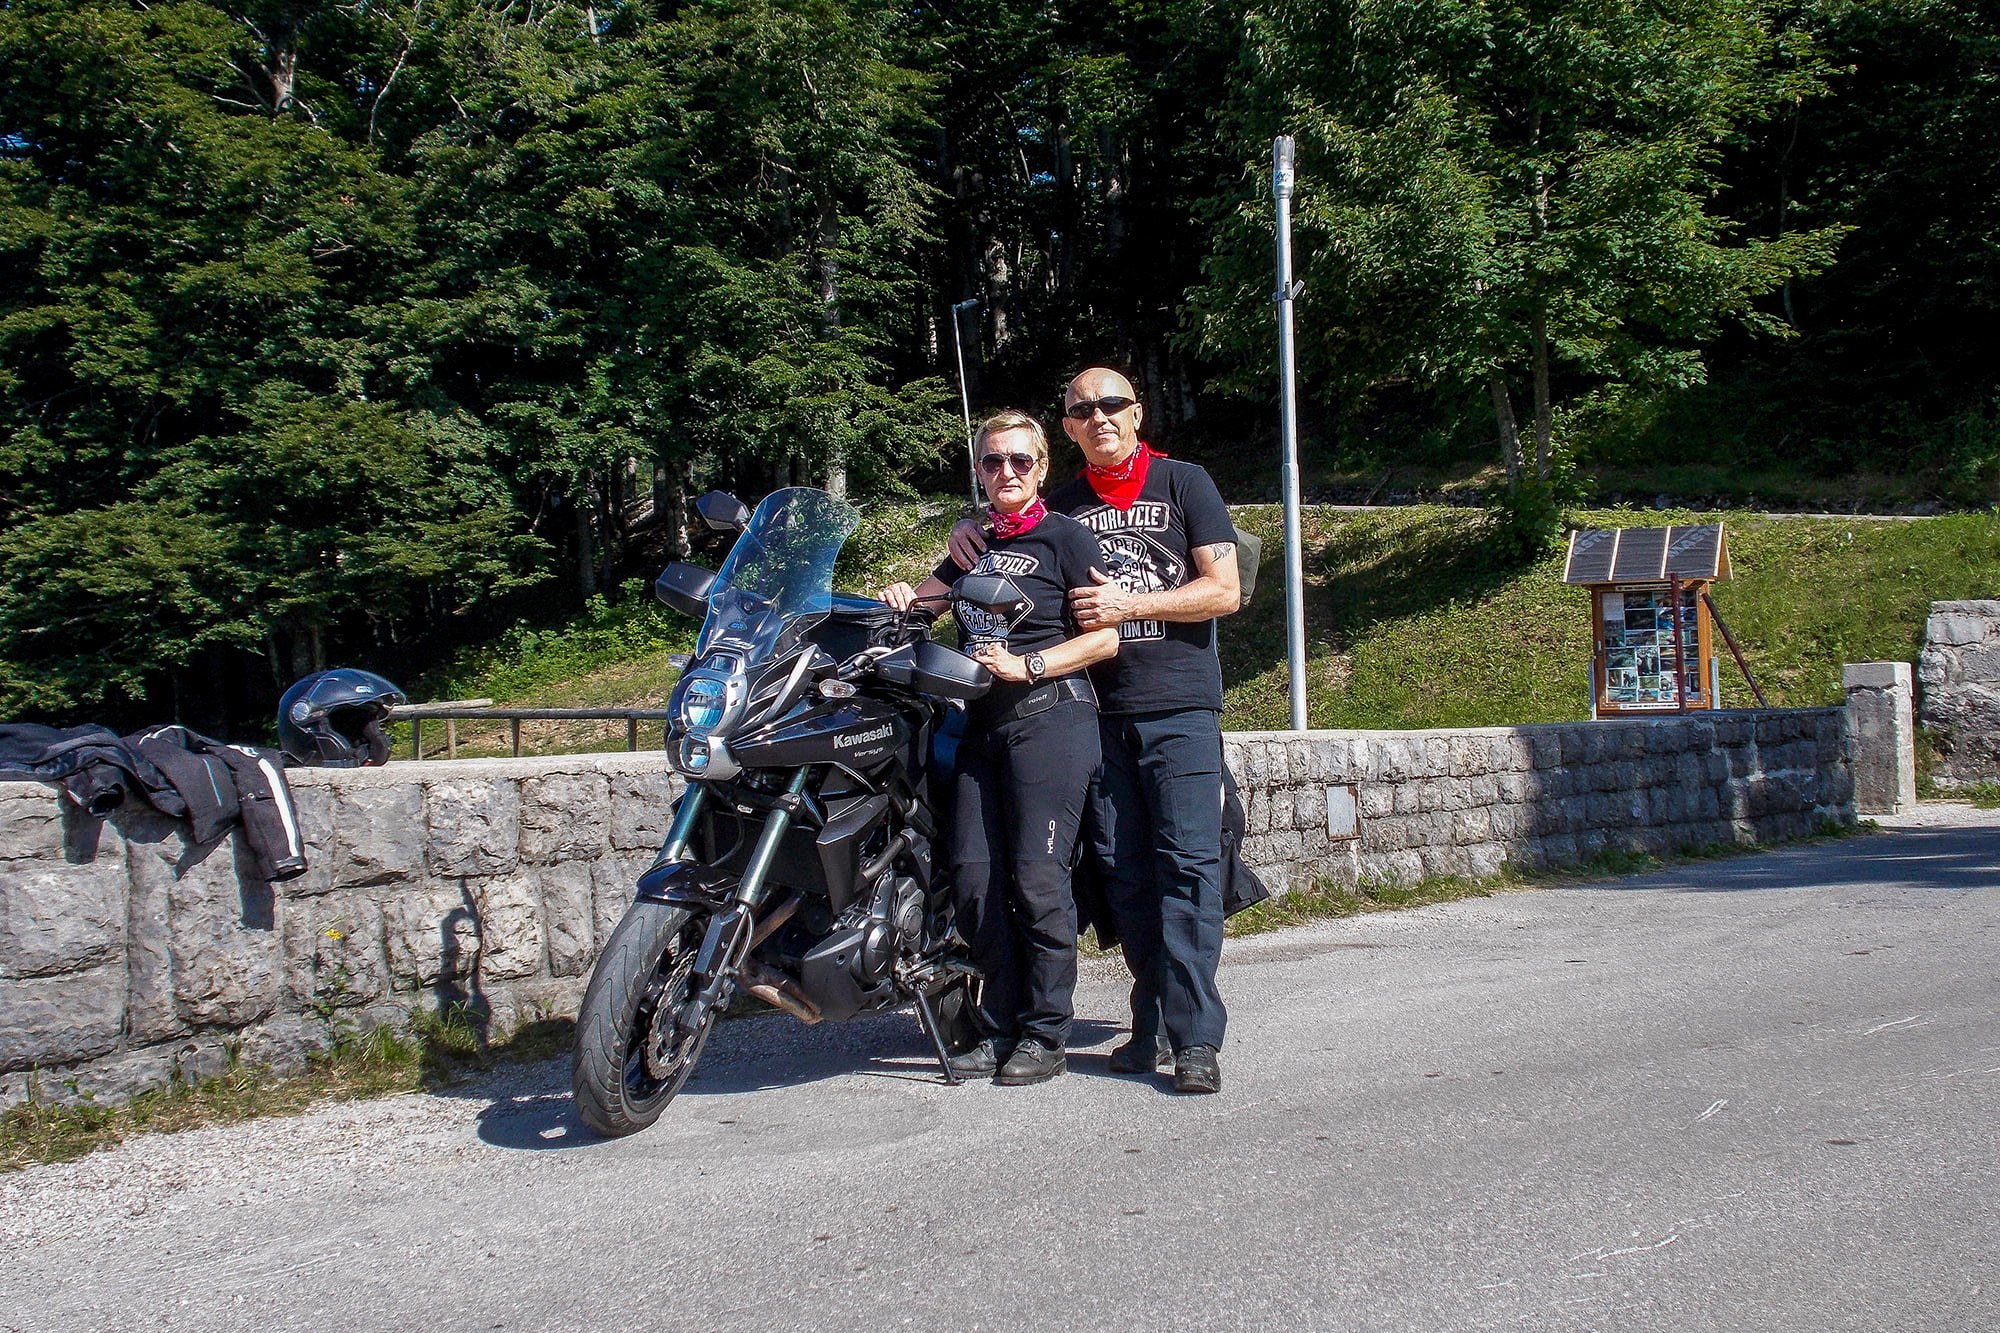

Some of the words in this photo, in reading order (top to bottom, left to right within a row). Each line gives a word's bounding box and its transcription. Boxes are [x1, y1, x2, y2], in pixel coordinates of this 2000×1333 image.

[1079, 505, 1162, 532] OTORCYCLE
[1144, 619, 1162, 637] CO.
[833, 722, 893, 750] Kawasaki
[1047, 819, 1056, 854] MILO
